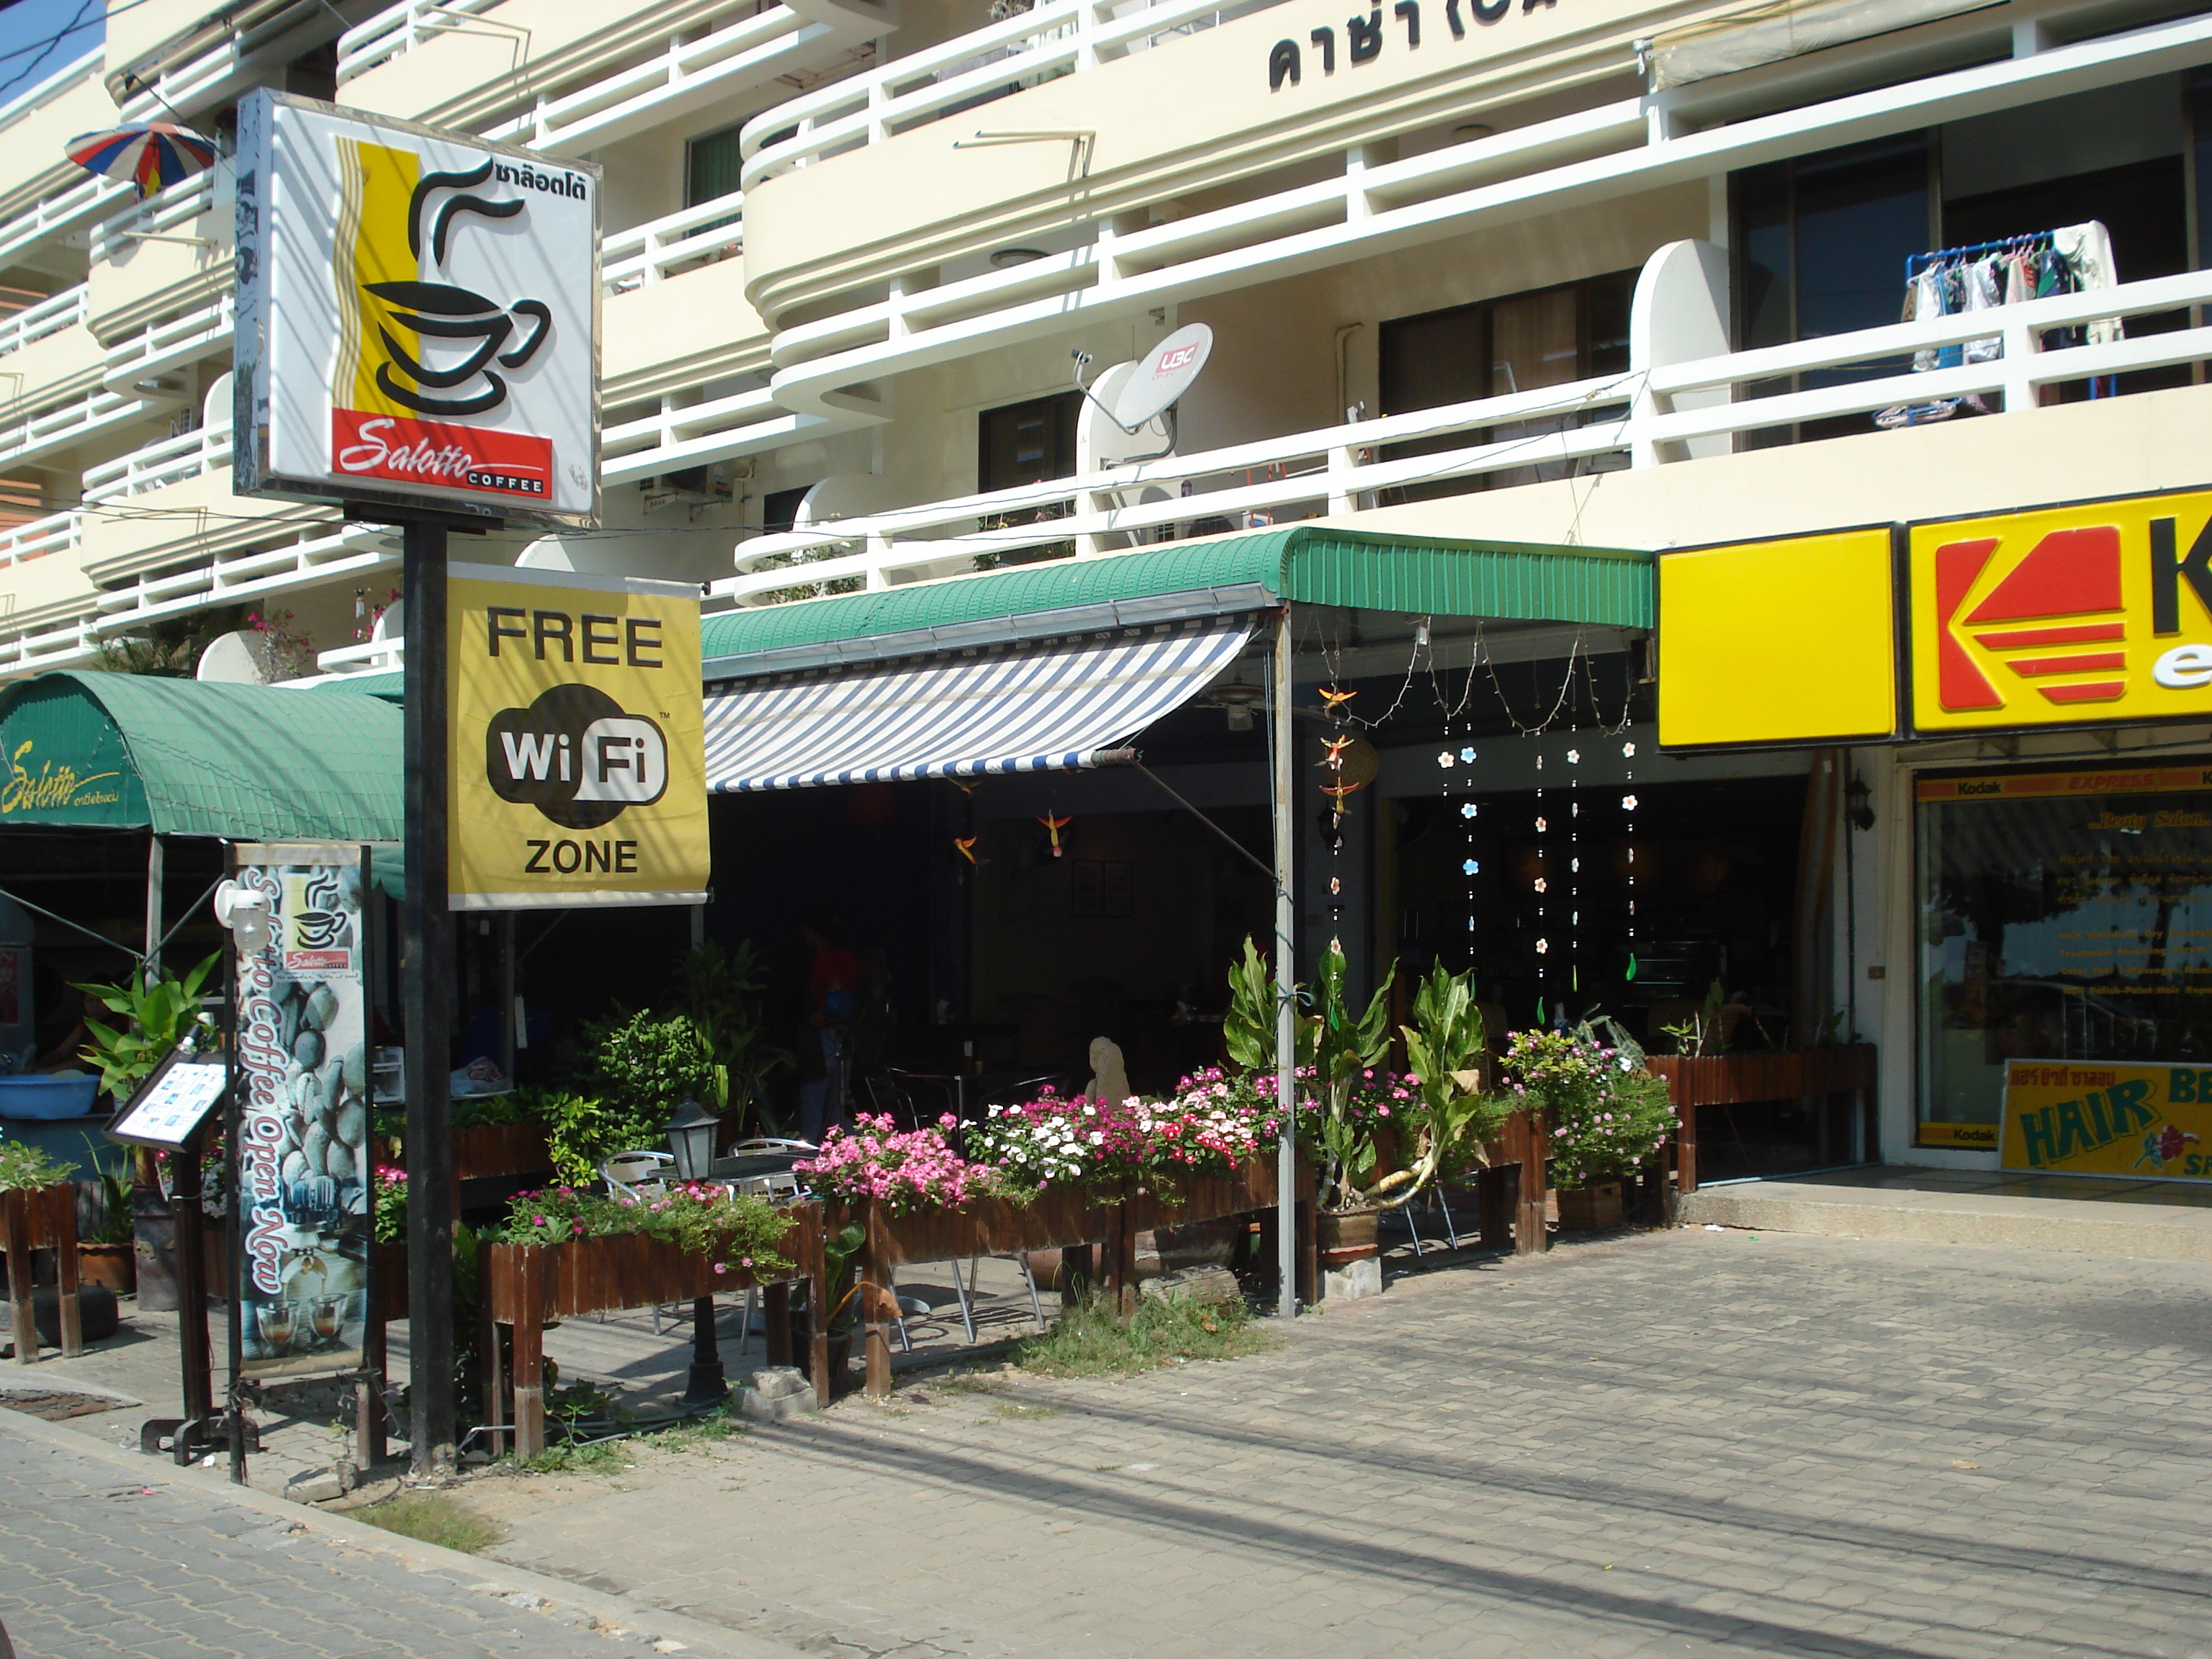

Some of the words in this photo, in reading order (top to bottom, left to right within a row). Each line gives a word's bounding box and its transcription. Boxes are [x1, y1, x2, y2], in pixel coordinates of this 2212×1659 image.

[338, 417, 544, 478] Salotto
[468, 472, 543, 493] COFFEE
[487, 605, 663, 669] FREE
[1958, 781, 2002, 796] Kodak
[2067, 773, 2154, 791] EXPRESS
[525, 839, 639, 873] ZONE
[242, 998, 287, 1106] Coffee
[1952, 1127, 1995, 1142] Kodak
[2019, 1078, 2162, 1169] HAIR
[243, 1116, 284, 1197] Open
[247, 1210, 288, 1292] Now
